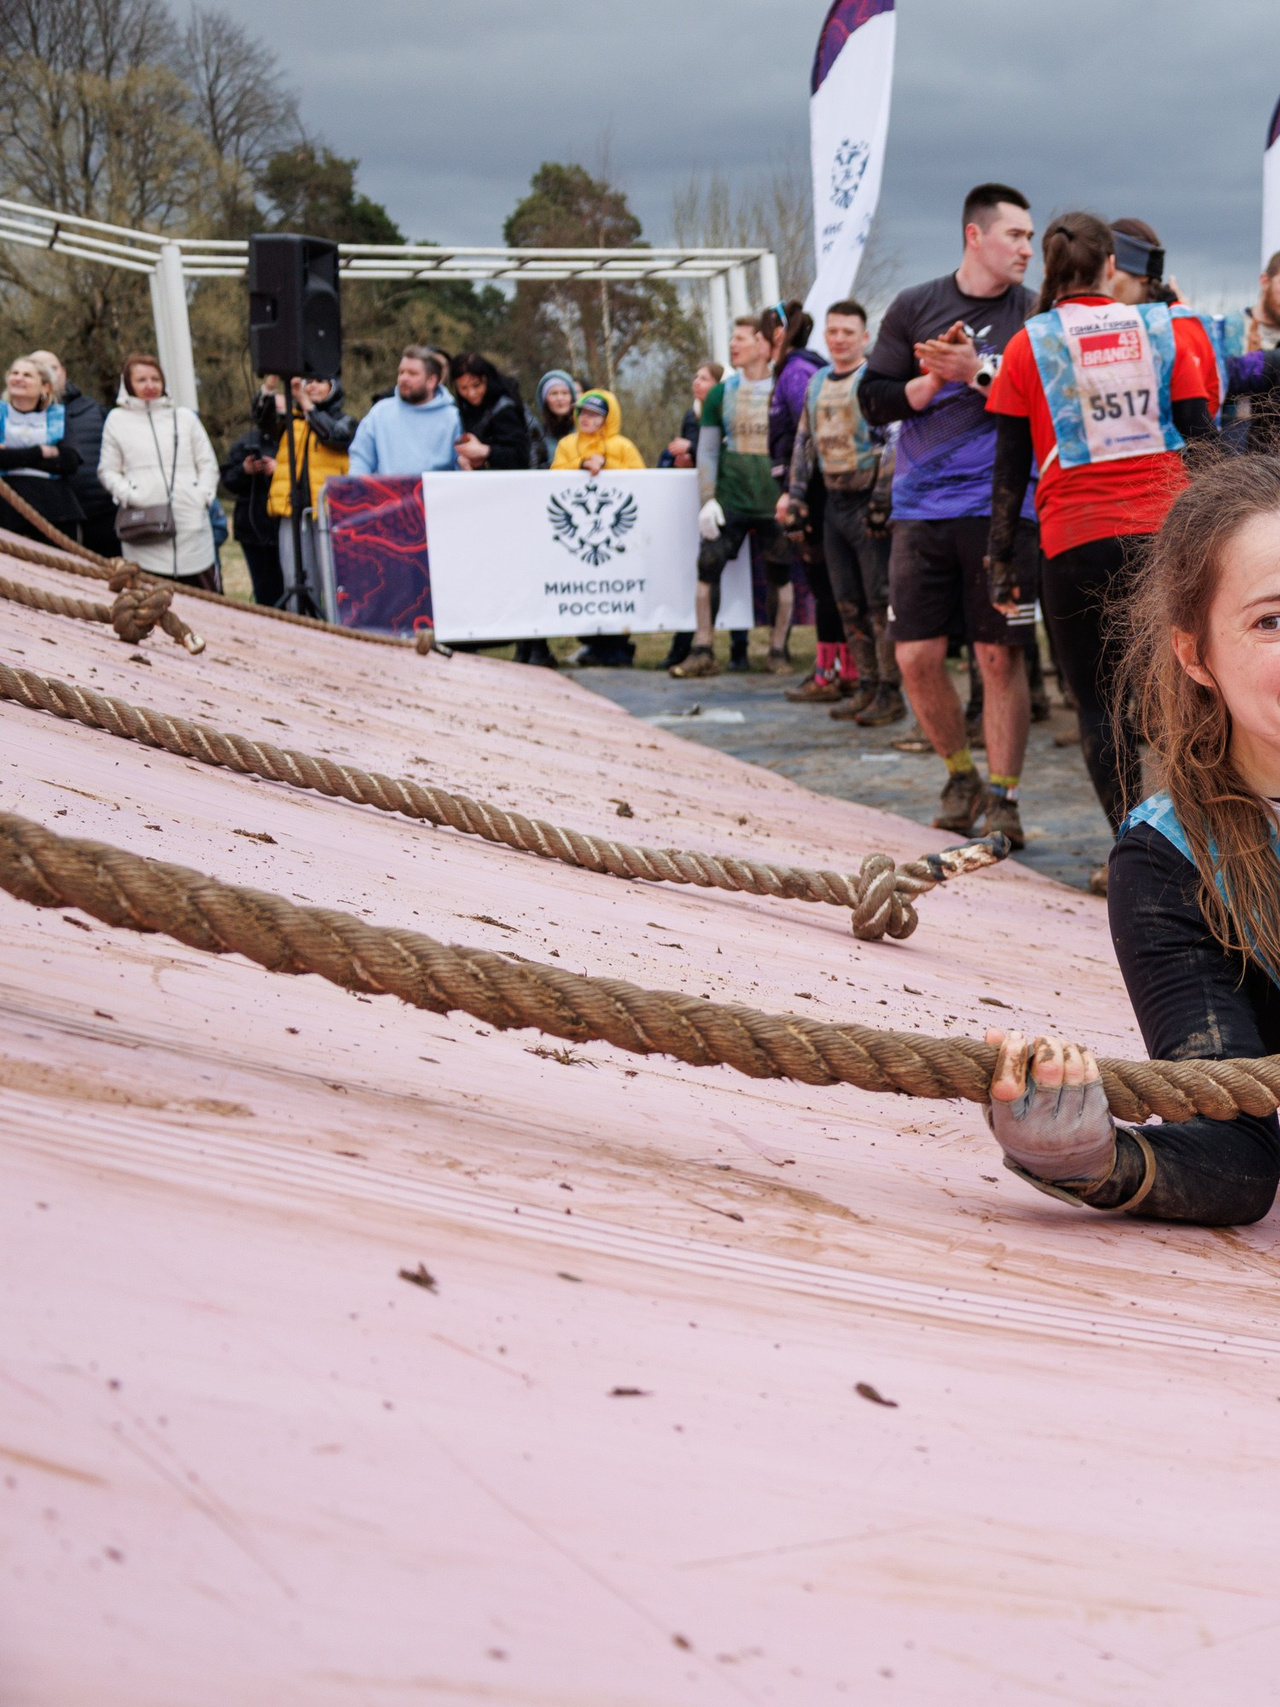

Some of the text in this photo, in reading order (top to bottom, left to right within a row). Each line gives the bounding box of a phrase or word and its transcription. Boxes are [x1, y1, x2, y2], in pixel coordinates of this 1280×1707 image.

[1118, 331, 1139, 346] 43
[1083, 346, 1140, 367] BRANDS
[1090, 389, 1150, 422] 5517
[544, 579, 646, 595] МИНСПОРТ
[558, 600, 635, 615] РОССИИ
